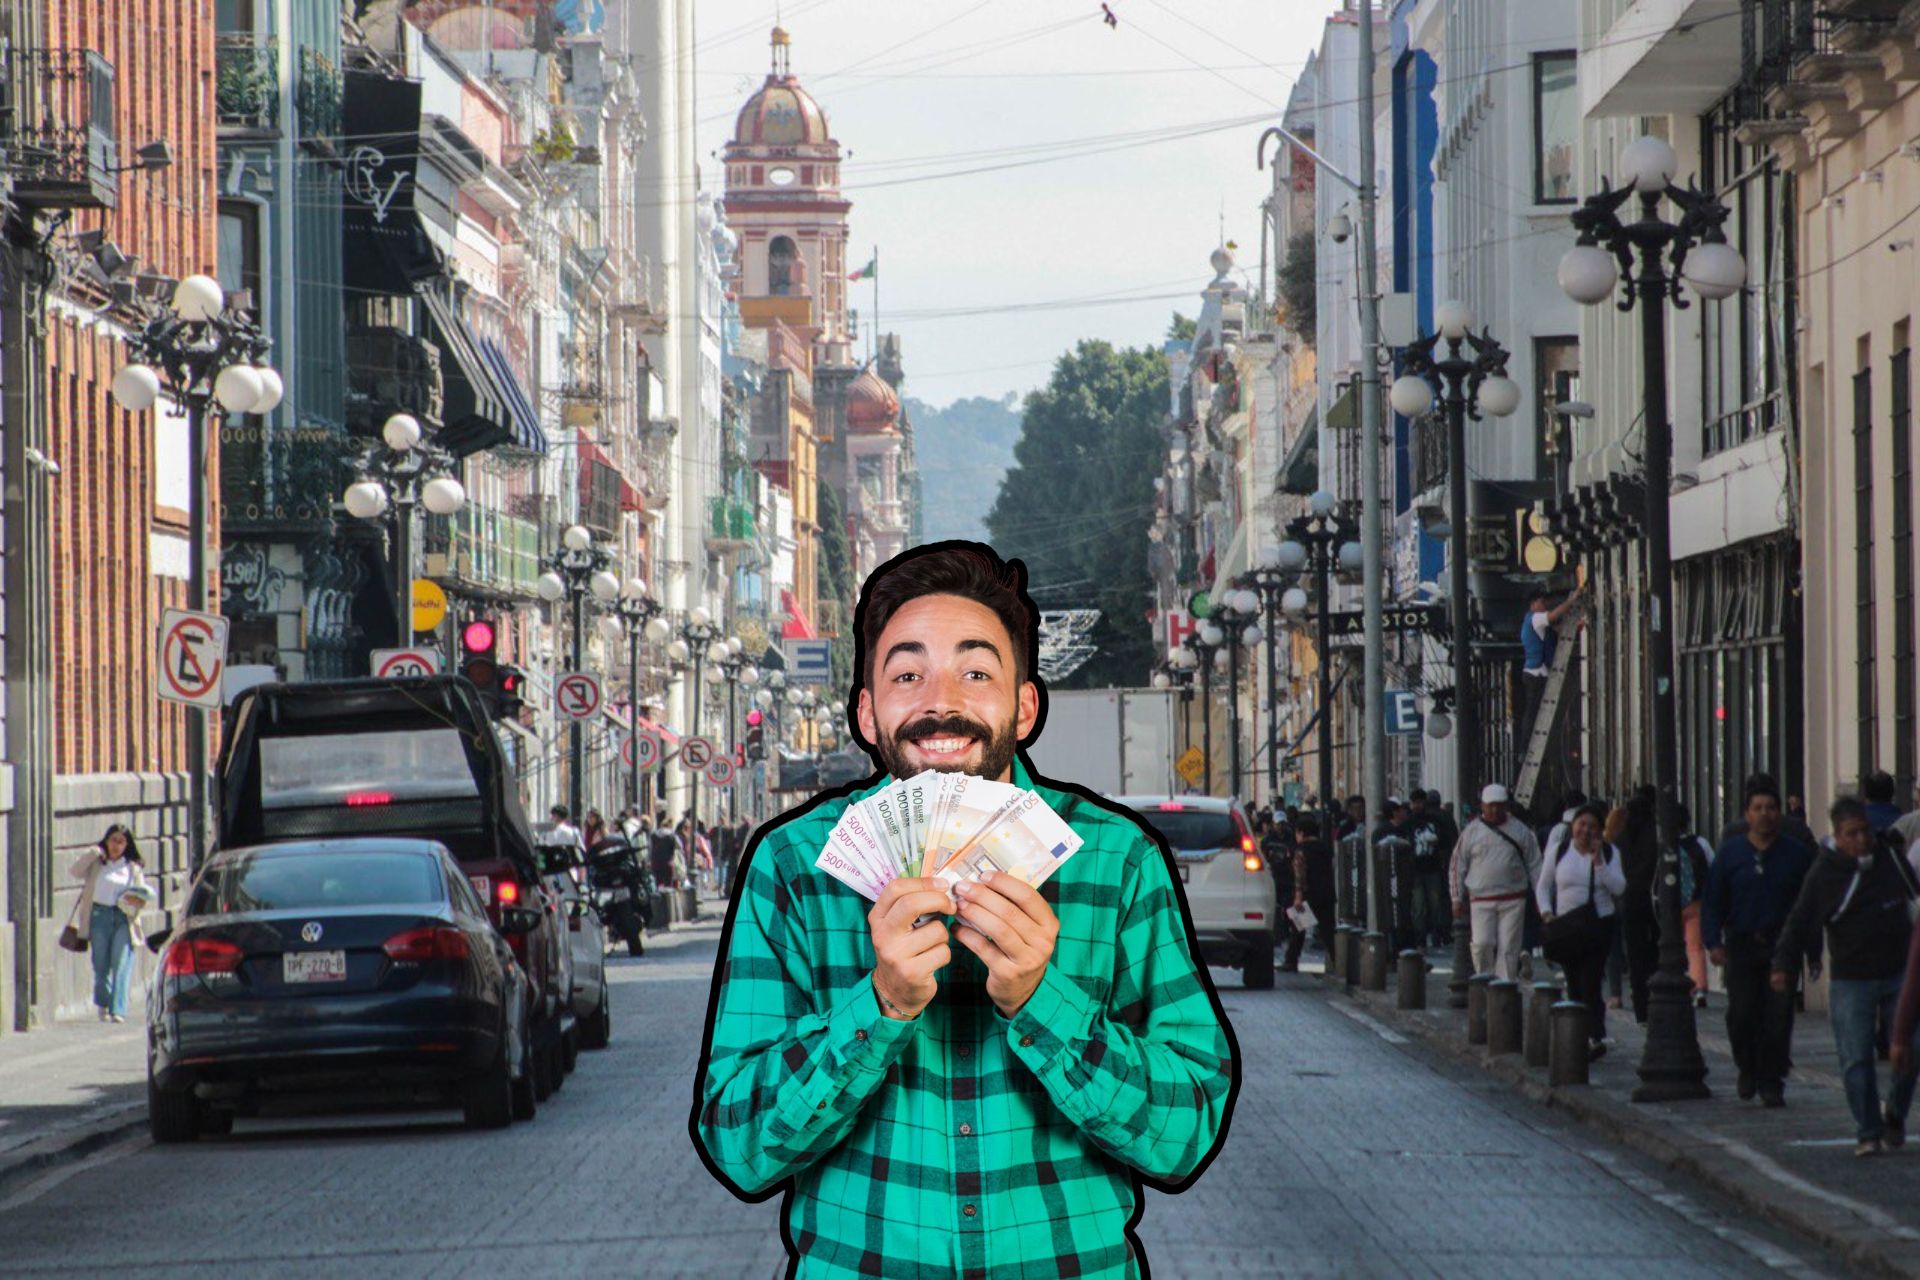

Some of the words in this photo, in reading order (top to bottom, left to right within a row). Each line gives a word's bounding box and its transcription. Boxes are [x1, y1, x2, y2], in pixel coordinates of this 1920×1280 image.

[1347, 612, 1429, 629] ASTOS
[1395, 693, 1419, 730] E
[712, 762, 728, 775] 30
[896, 790, 908, 809] 100
[912, 786, 924, 805] 100
[1023, 793, 1039, 810] 50
[878, 800, 892, 819] 100
[887, 817, 899, 835] EURO
[835, 828, 854, 847] 500
[846, 816, 864, 835] 500
[861, 832, 876, 849] EURO
[824, 852, 844, 869] 500
[842, 863, 861, 877] EURO
